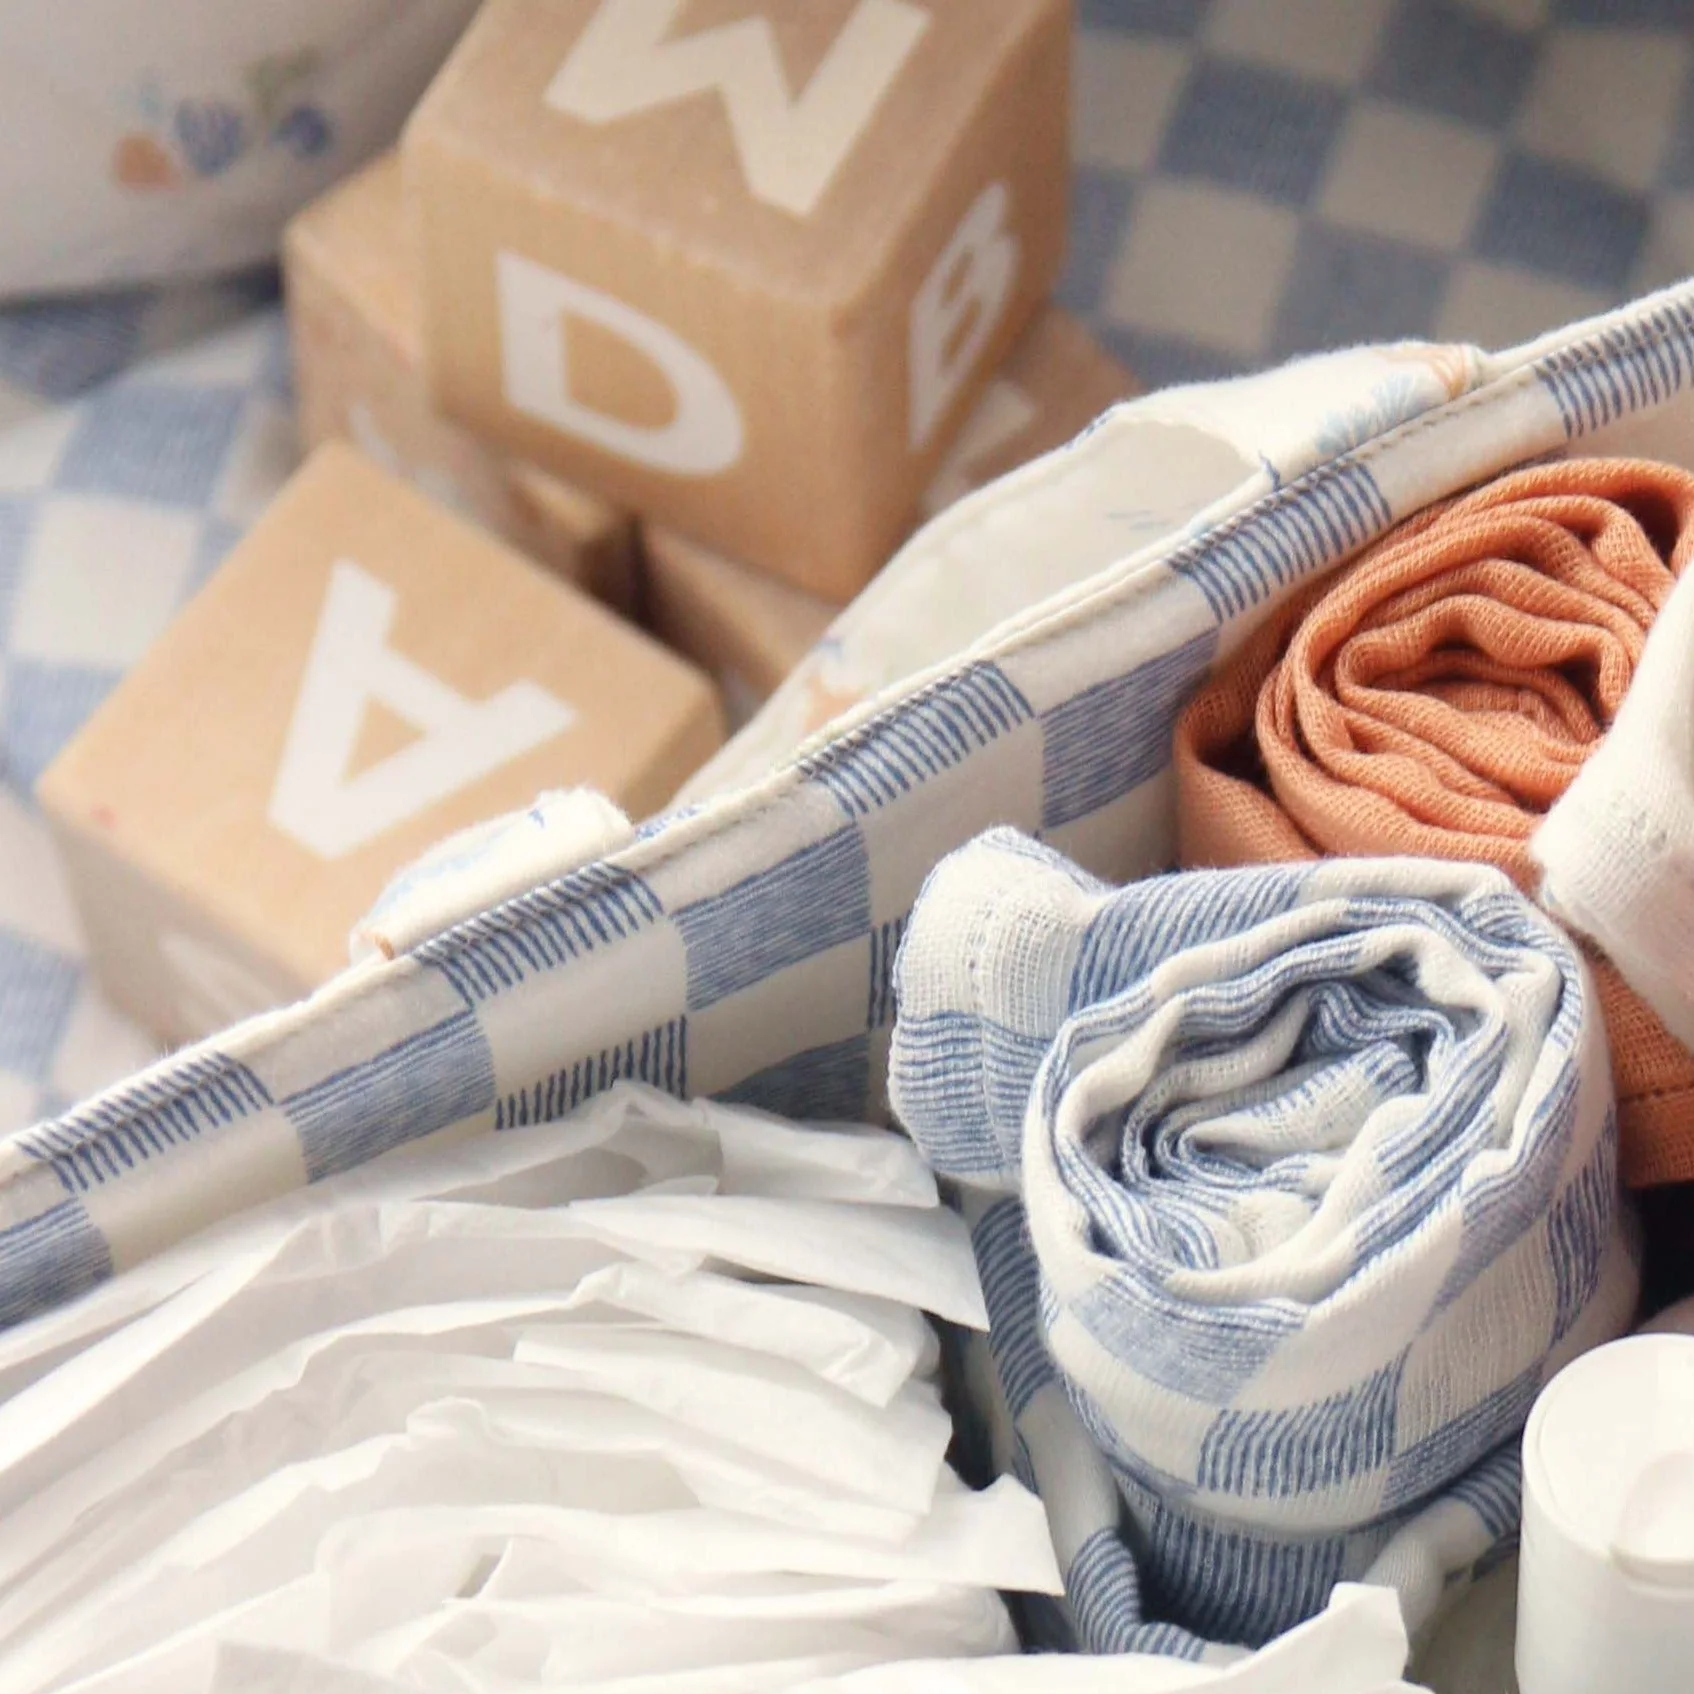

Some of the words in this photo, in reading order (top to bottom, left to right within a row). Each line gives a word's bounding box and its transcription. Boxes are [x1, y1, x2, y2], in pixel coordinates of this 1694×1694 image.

[495, 248, 743, 476] D
[908, 180, 1019, 447] B
[267, 556, 577, 858] A
